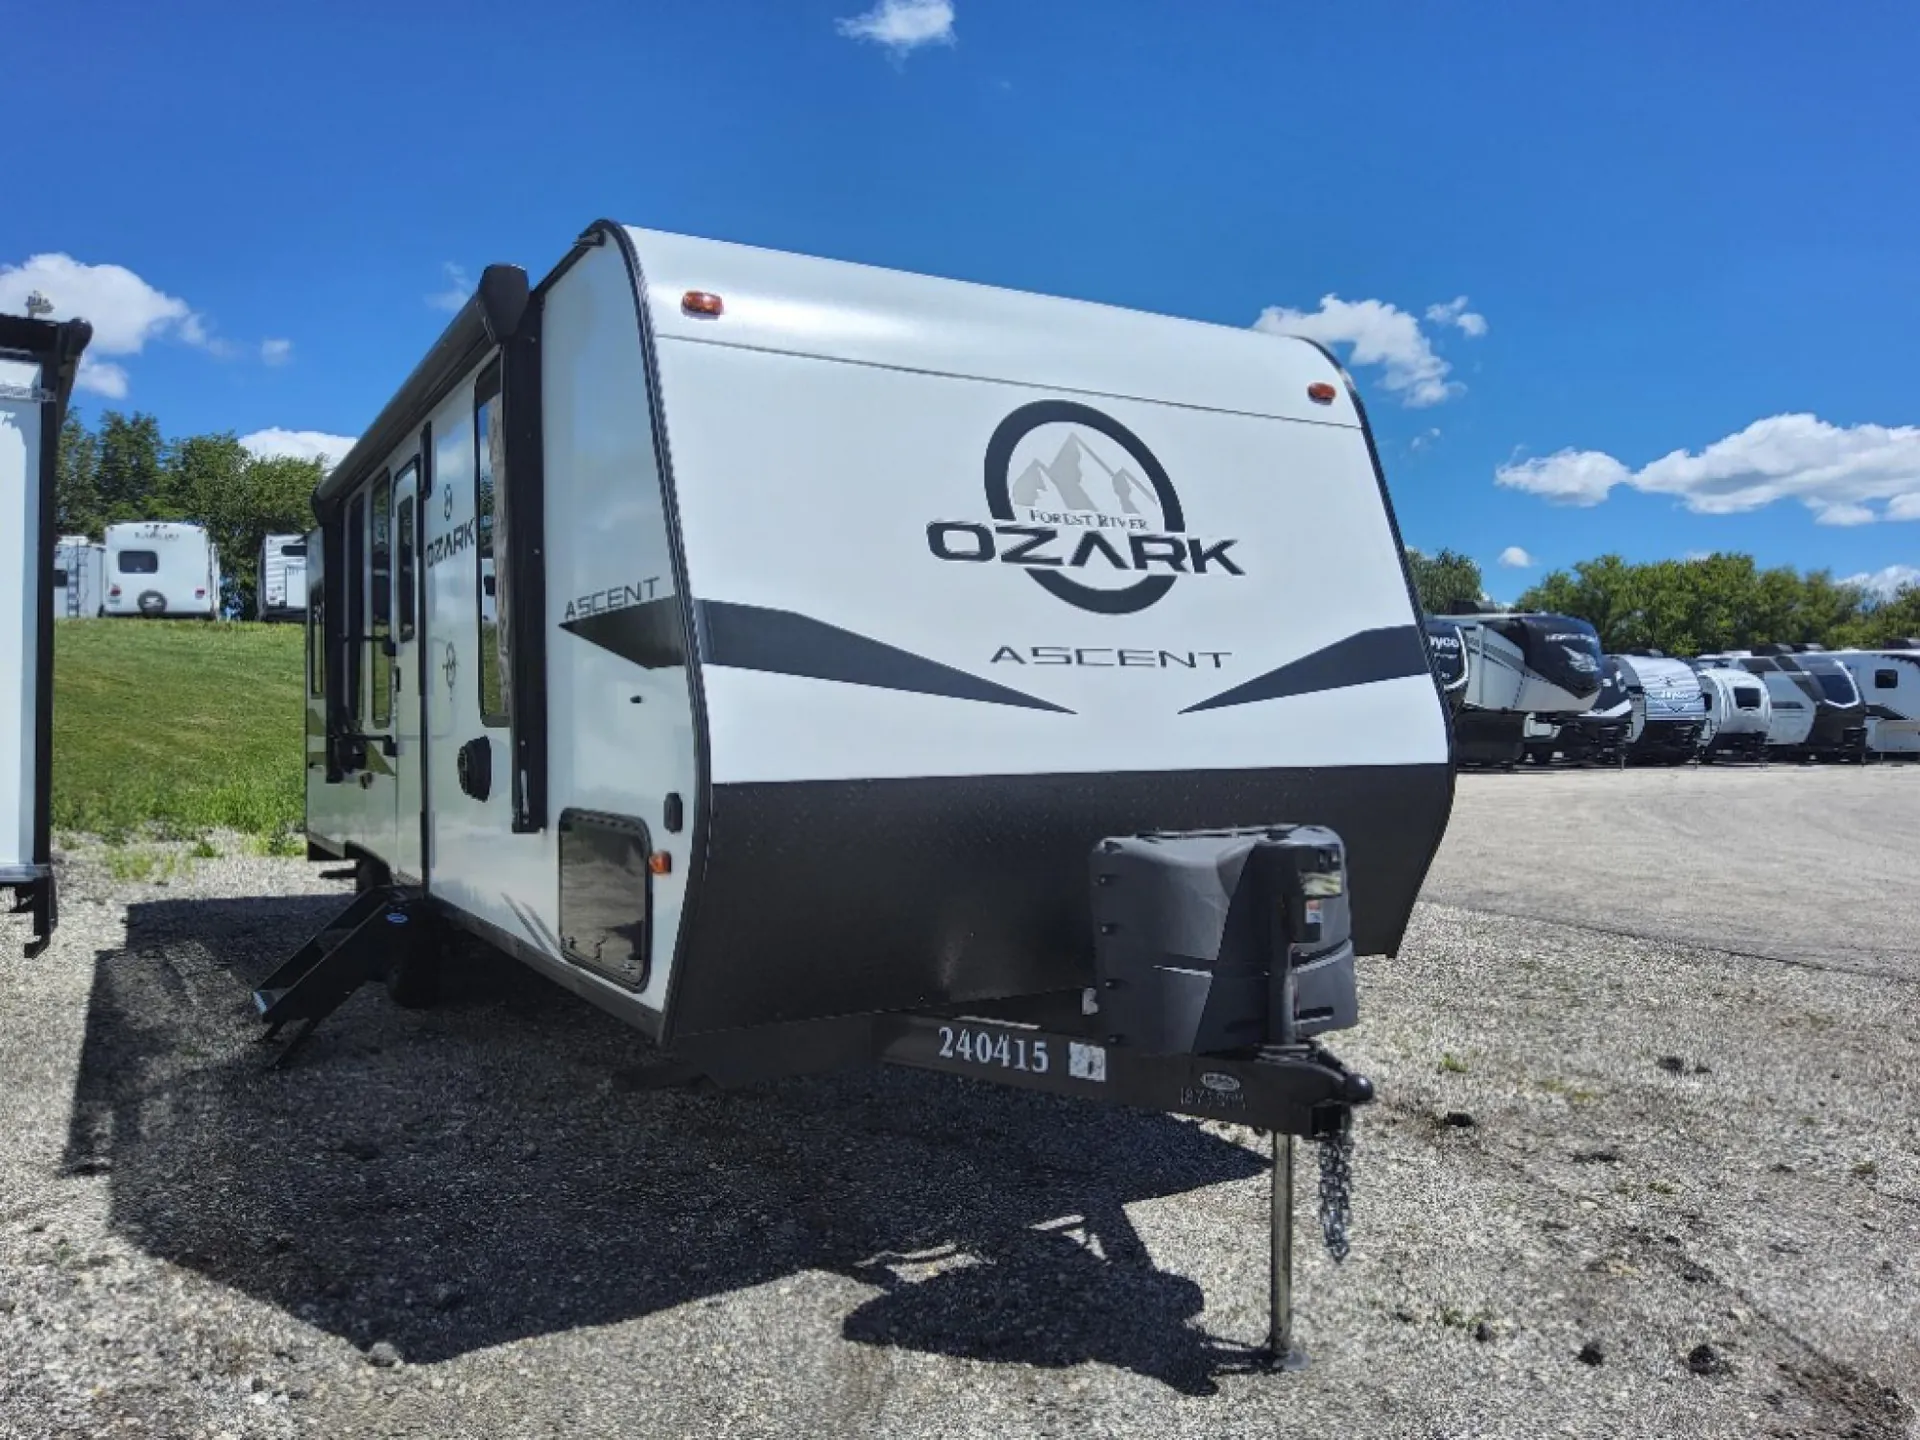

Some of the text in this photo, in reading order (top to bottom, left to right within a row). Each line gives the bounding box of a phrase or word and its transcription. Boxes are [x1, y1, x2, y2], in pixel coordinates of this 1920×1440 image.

[427, 517, 476, 568] OZARK
[1029, 509, 1150, 531] FOREST RIVER
[926, 520, 1246, 576] OZARK
[564, 576, 660, 620] ASCENT
[990, 645, 1232, 668] ASCENT
[938, 1026, 1049, 1073] 240415
